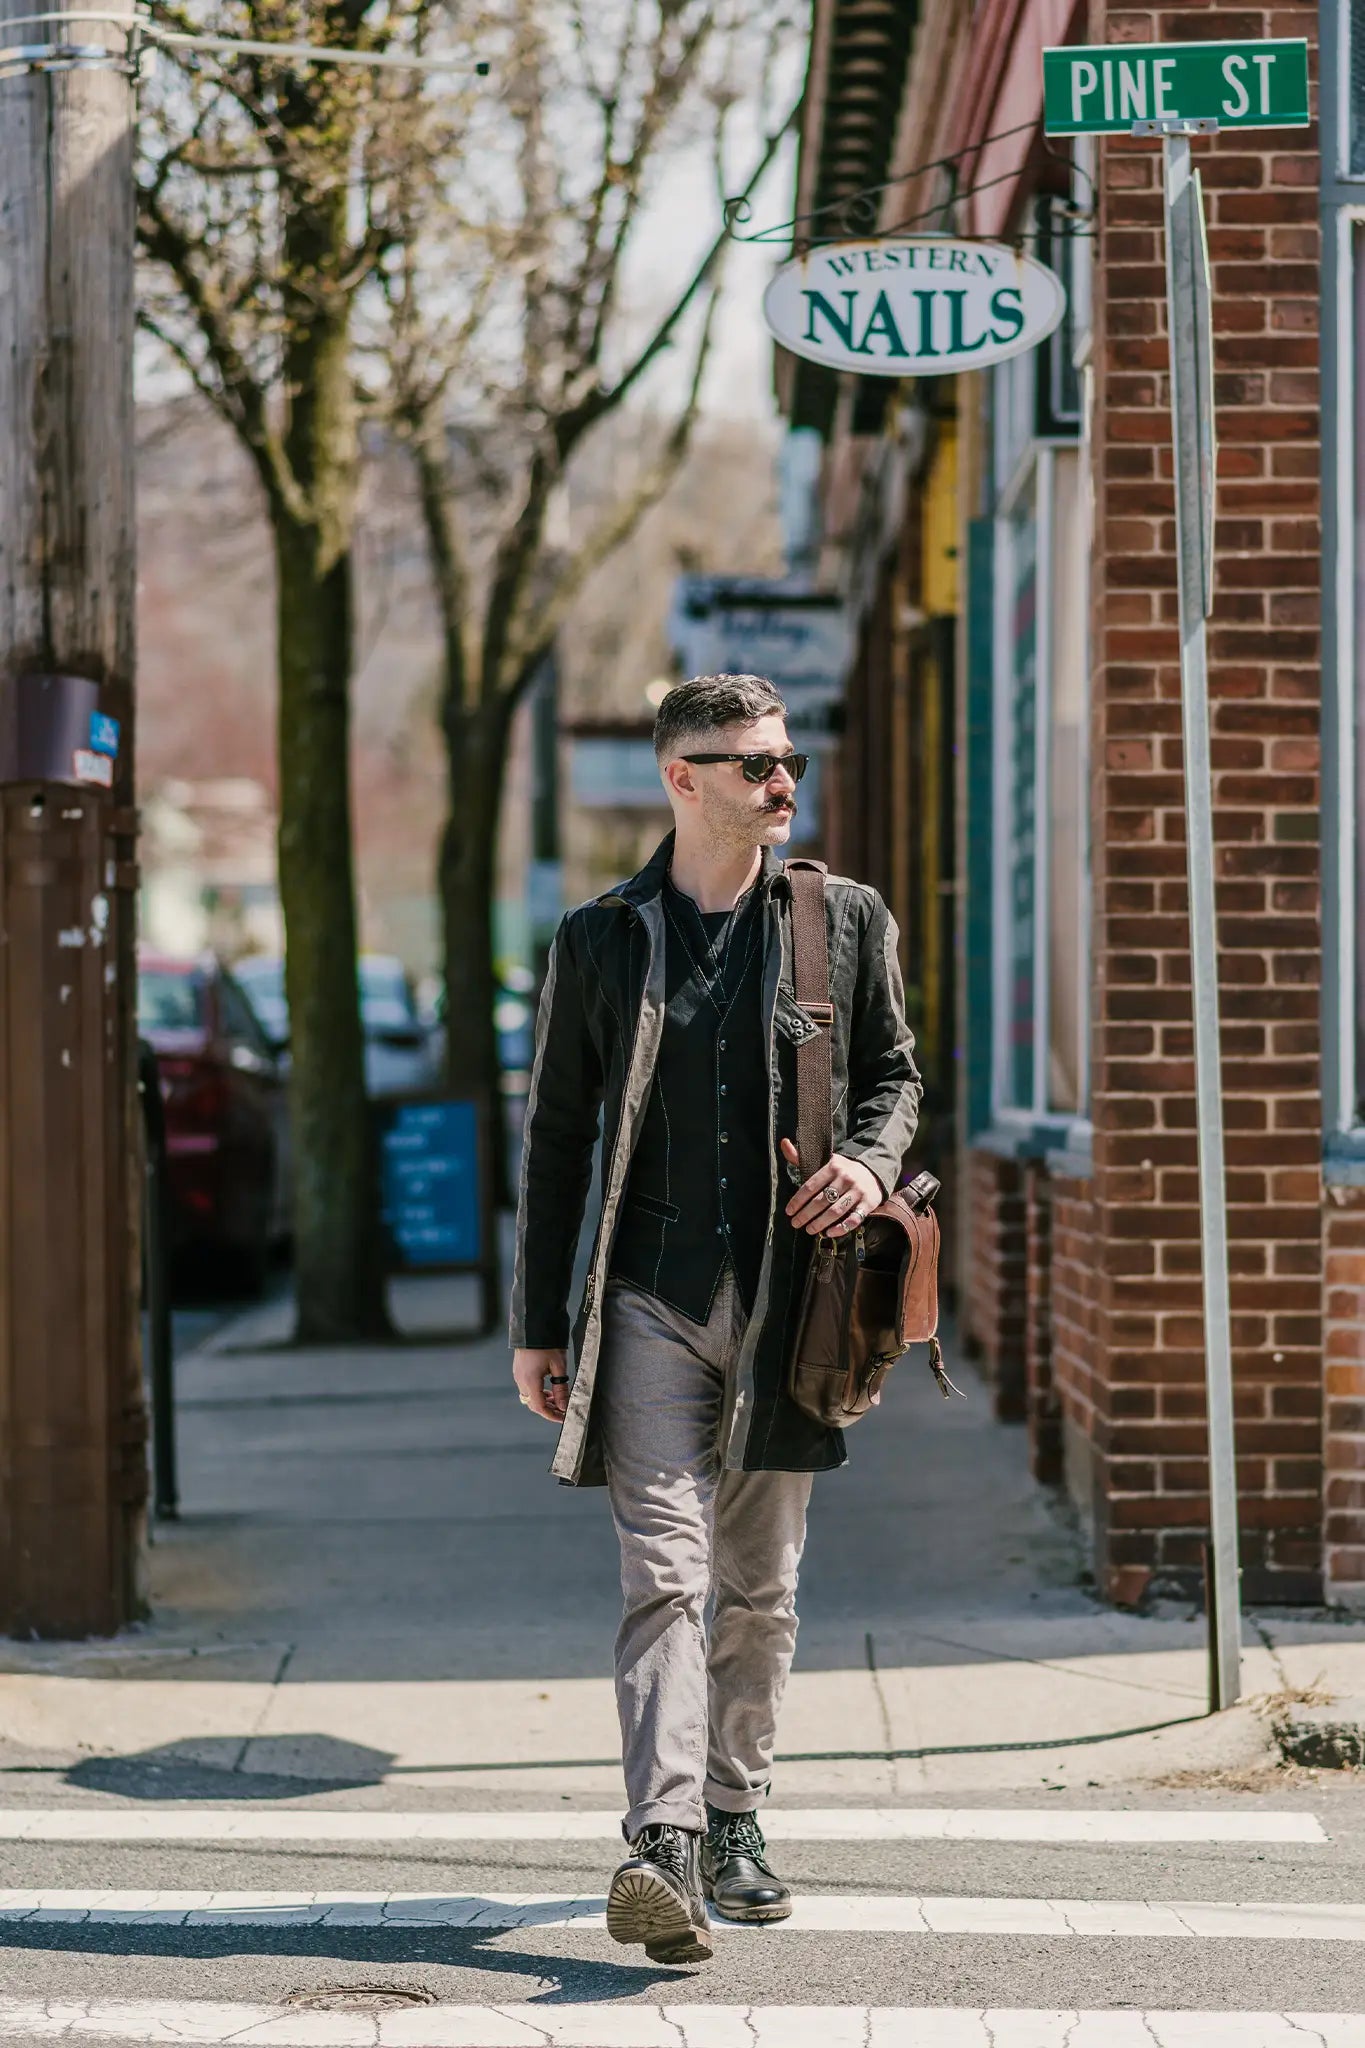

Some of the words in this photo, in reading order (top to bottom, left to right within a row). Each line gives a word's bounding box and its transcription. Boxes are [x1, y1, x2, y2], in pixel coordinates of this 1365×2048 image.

[1071, 58, 1179, 122] PINE
[1221, 54, 1276, 118] ST
[827, 247, 999, 277] WESTERN
[801, 288, 1025, 357] NAILS
